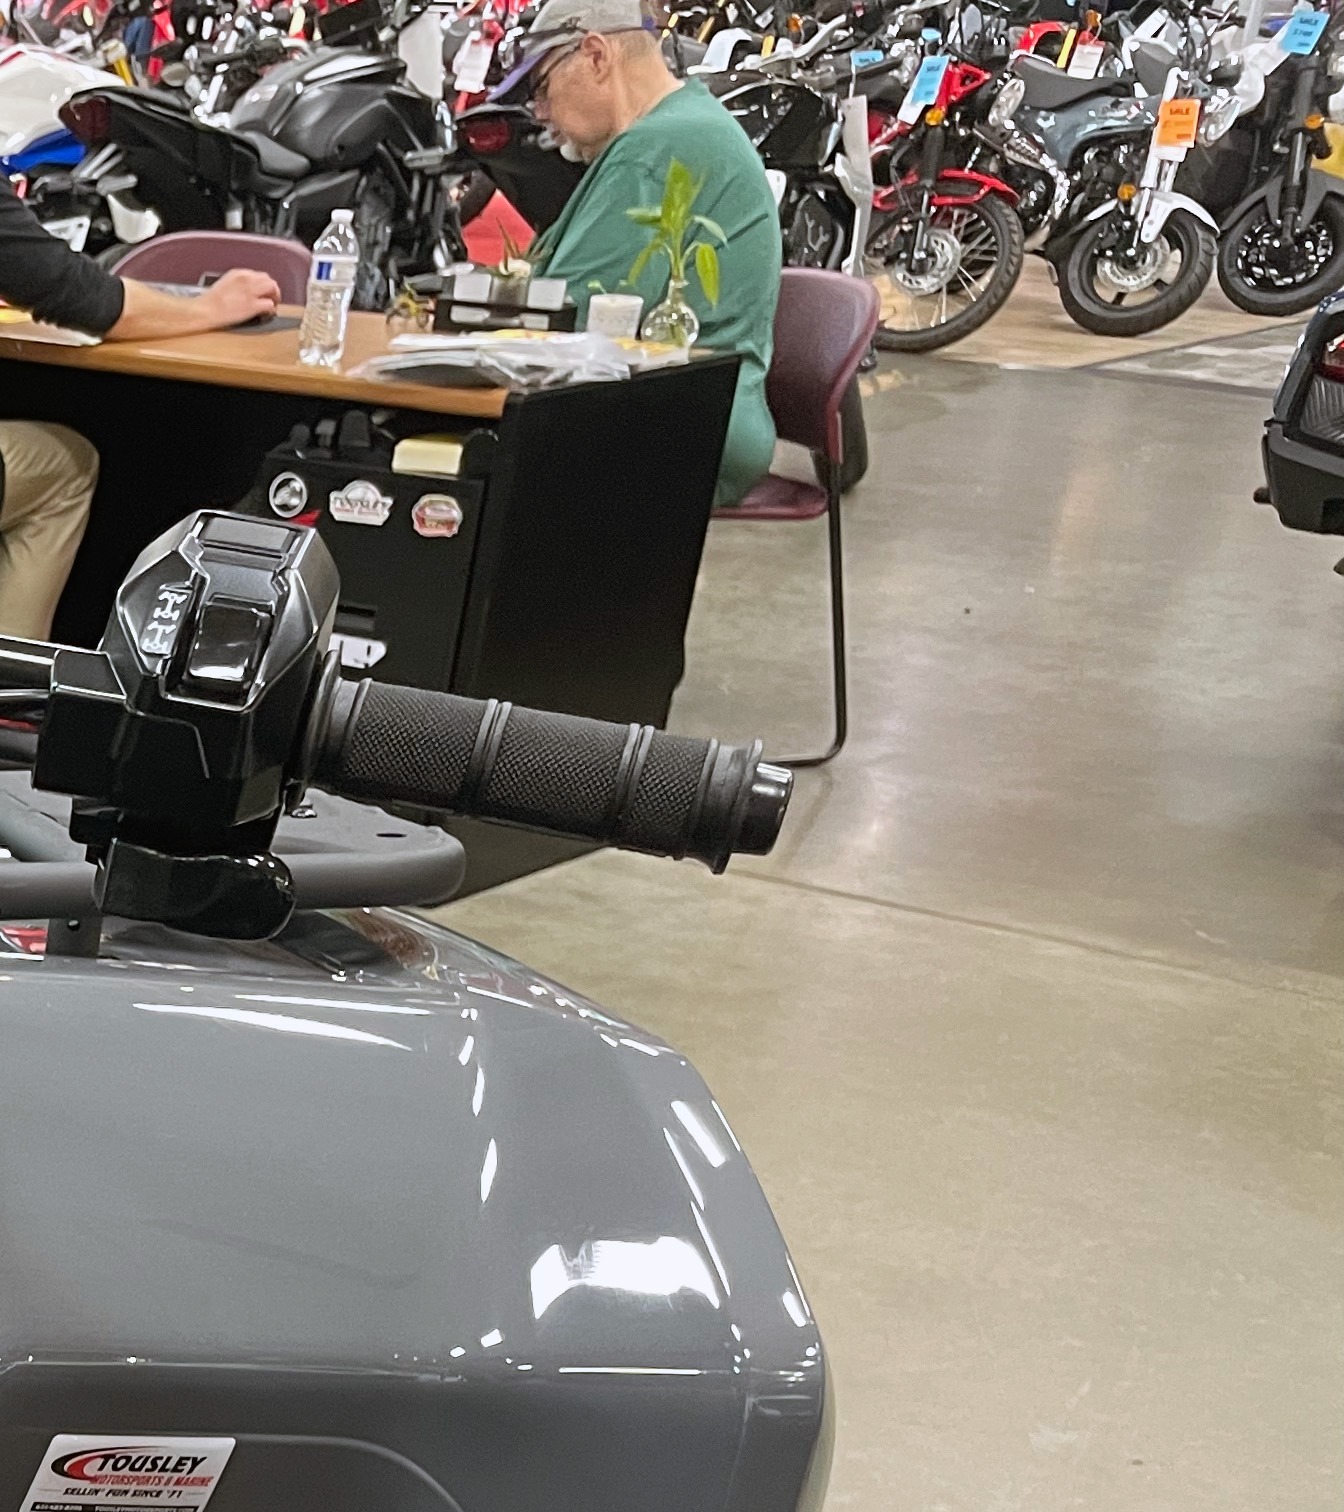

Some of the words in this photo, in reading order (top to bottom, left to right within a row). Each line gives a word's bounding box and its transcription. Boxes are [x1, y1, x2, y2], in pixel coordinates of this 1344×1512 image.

[98, 1454, 207, 1475] TOUSLEY
[89, 1475, 164, 1486] MOTORSPORTS
[164, 1476, 172, 1486] &
[174, 1476, 214, 1487] MARINE
[63, 1488, 106, 1497] SELLIN'
[106, 1488, 130, 1498] FUN
[131, 1489, 163, 1498] SINCE
